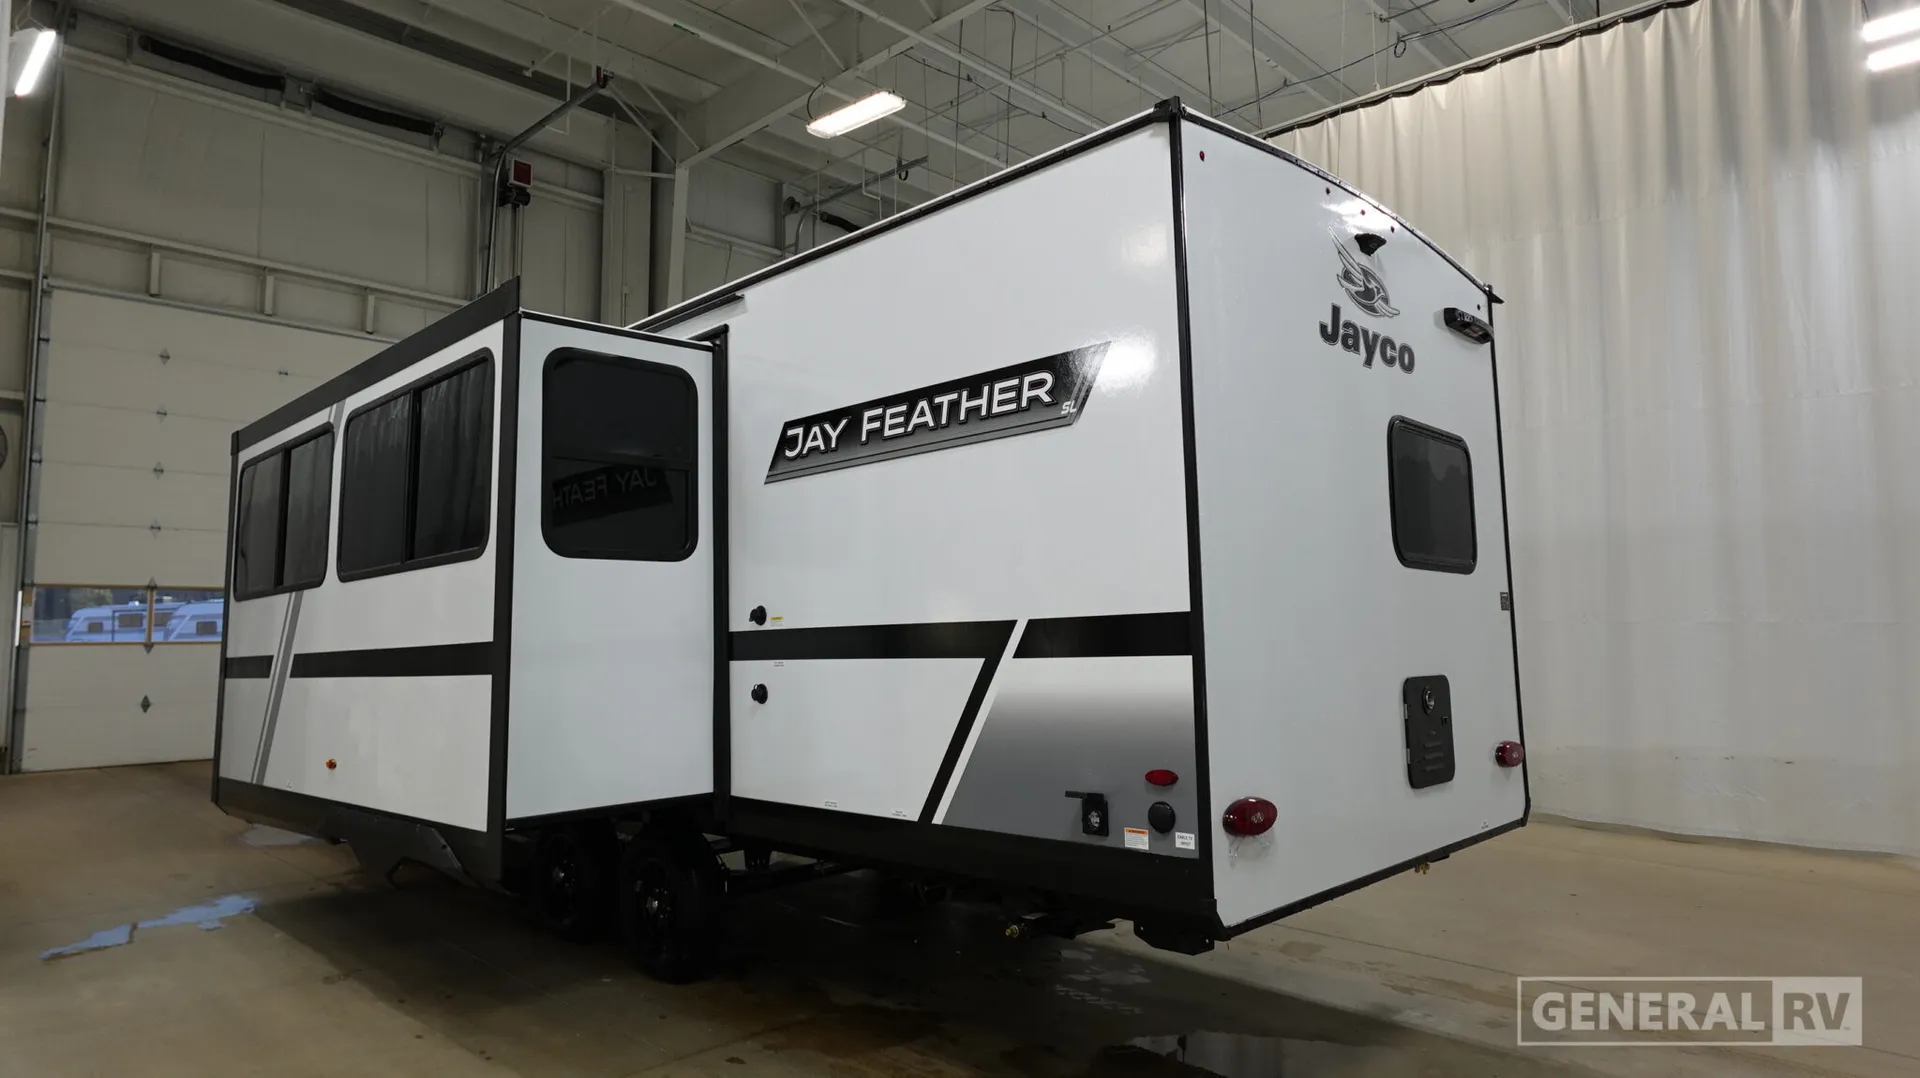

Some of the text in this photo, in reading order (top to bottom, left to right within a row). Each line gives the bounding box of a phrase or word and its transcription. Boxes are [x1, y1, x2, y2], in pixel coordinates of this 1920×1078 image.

[1319, 303, 1415, 374] Jayco
[784, 371, 1054, 458] JAY FEATHER
[1061, 400, 1077, 415] SL
